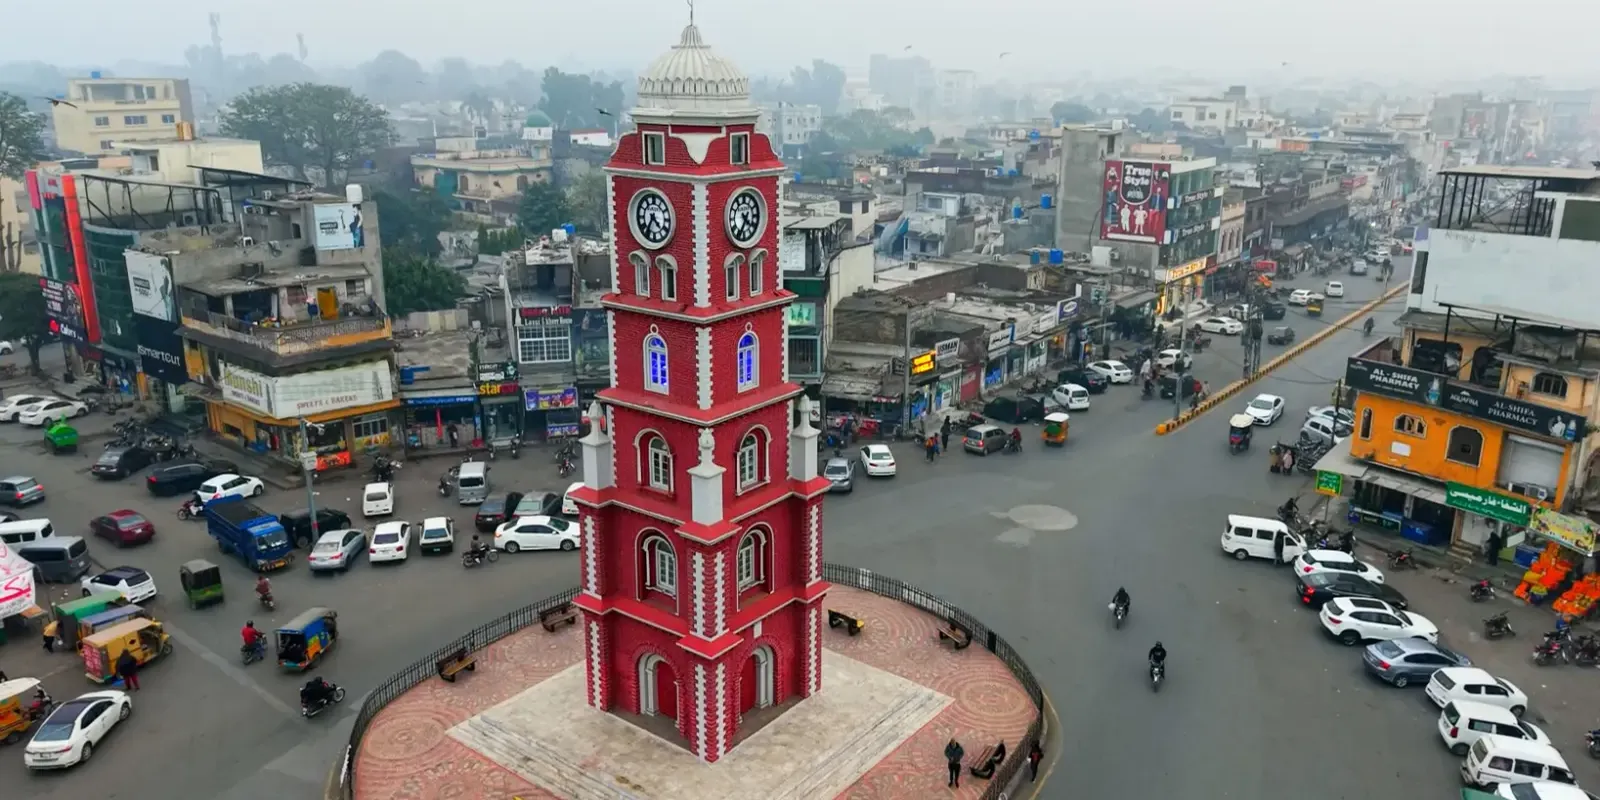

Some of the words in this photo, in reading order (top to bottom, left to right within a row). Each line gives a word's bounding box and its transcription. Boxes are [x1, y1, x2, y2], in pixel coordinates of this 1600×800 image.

[1125, 165, 1151, 176] True
[1124, 176, 1149, 185] Style
[1369, 374, 1420, 390] PHARMACY
[1373, 368, 1385, 376] AL
[1392, 372, 1418, 383] SHIFA
[480, 382, 501, 396] star
[1488, 408, 1538, 426] PHARMACY
